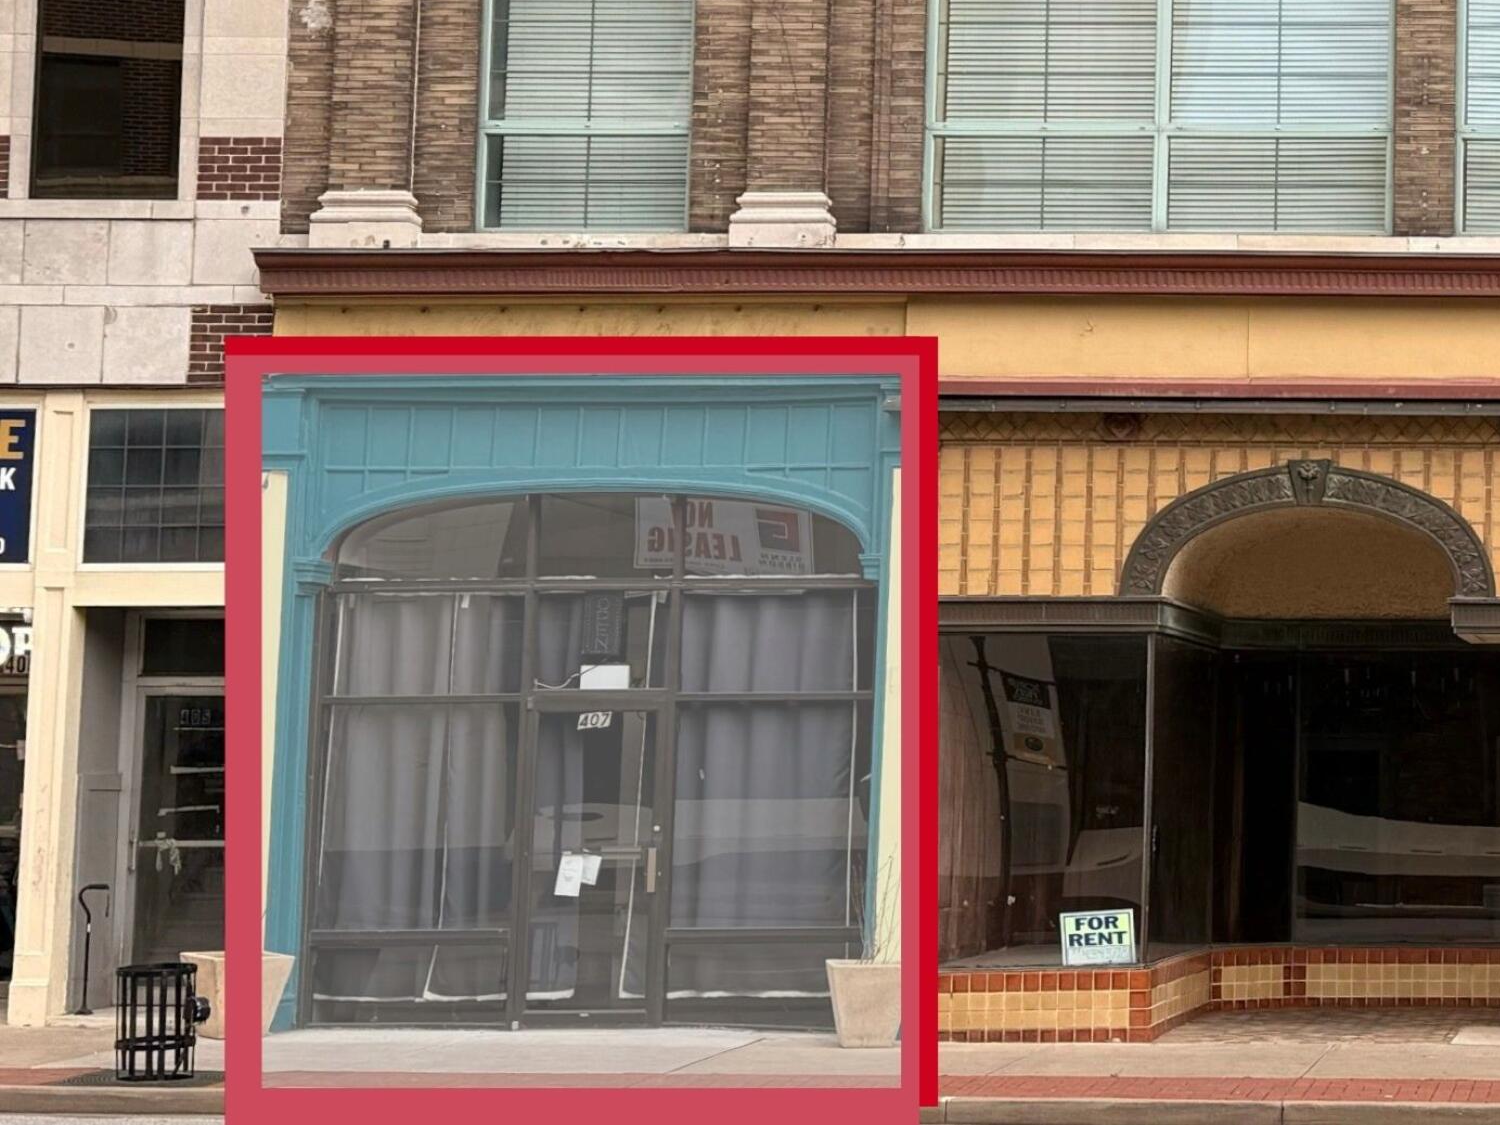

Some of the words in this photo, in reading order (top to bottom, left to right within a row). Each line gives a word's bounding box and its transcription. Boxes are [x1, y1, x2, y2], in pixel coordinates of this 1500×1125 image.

[579, 712, 610, 727] 407
[1075, 916, 1119, 931] FOR
[1069, 931, 1127, 947] RENT
